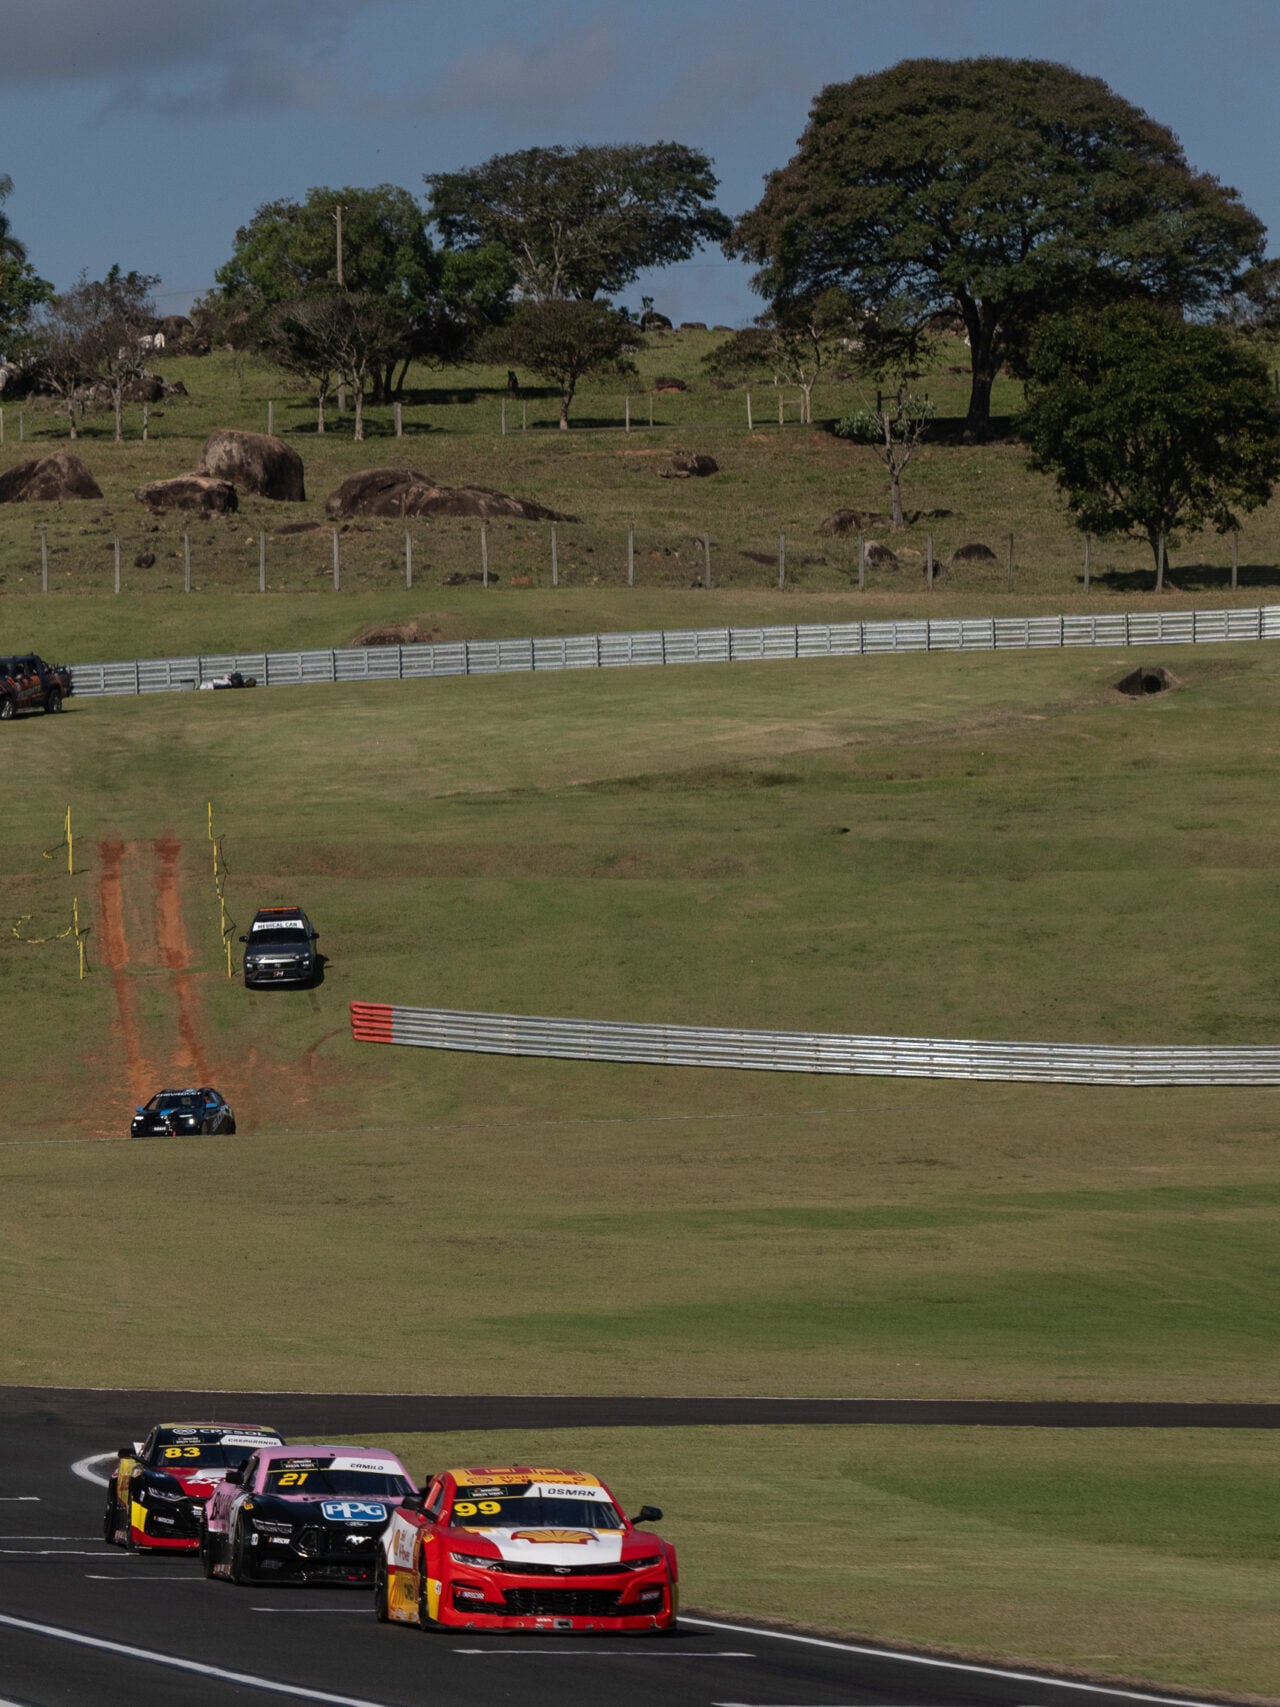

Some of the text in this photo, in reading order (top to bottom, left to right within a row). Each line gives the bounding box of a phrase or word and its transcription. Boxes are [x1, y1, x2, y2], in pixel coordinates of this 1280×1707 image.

[200, 1428, 268, 1437] CRESOL
[164, 1446, 201, 1459] 83
[350, 1463, 384, 1471] CAMILO
[277, 1472, 309, 1486] 21
[547, 1488, 596, 1497] OSMAN
[327, 1502, 382, 1518] PPG
[453, 1501, 502, 1518] 99
